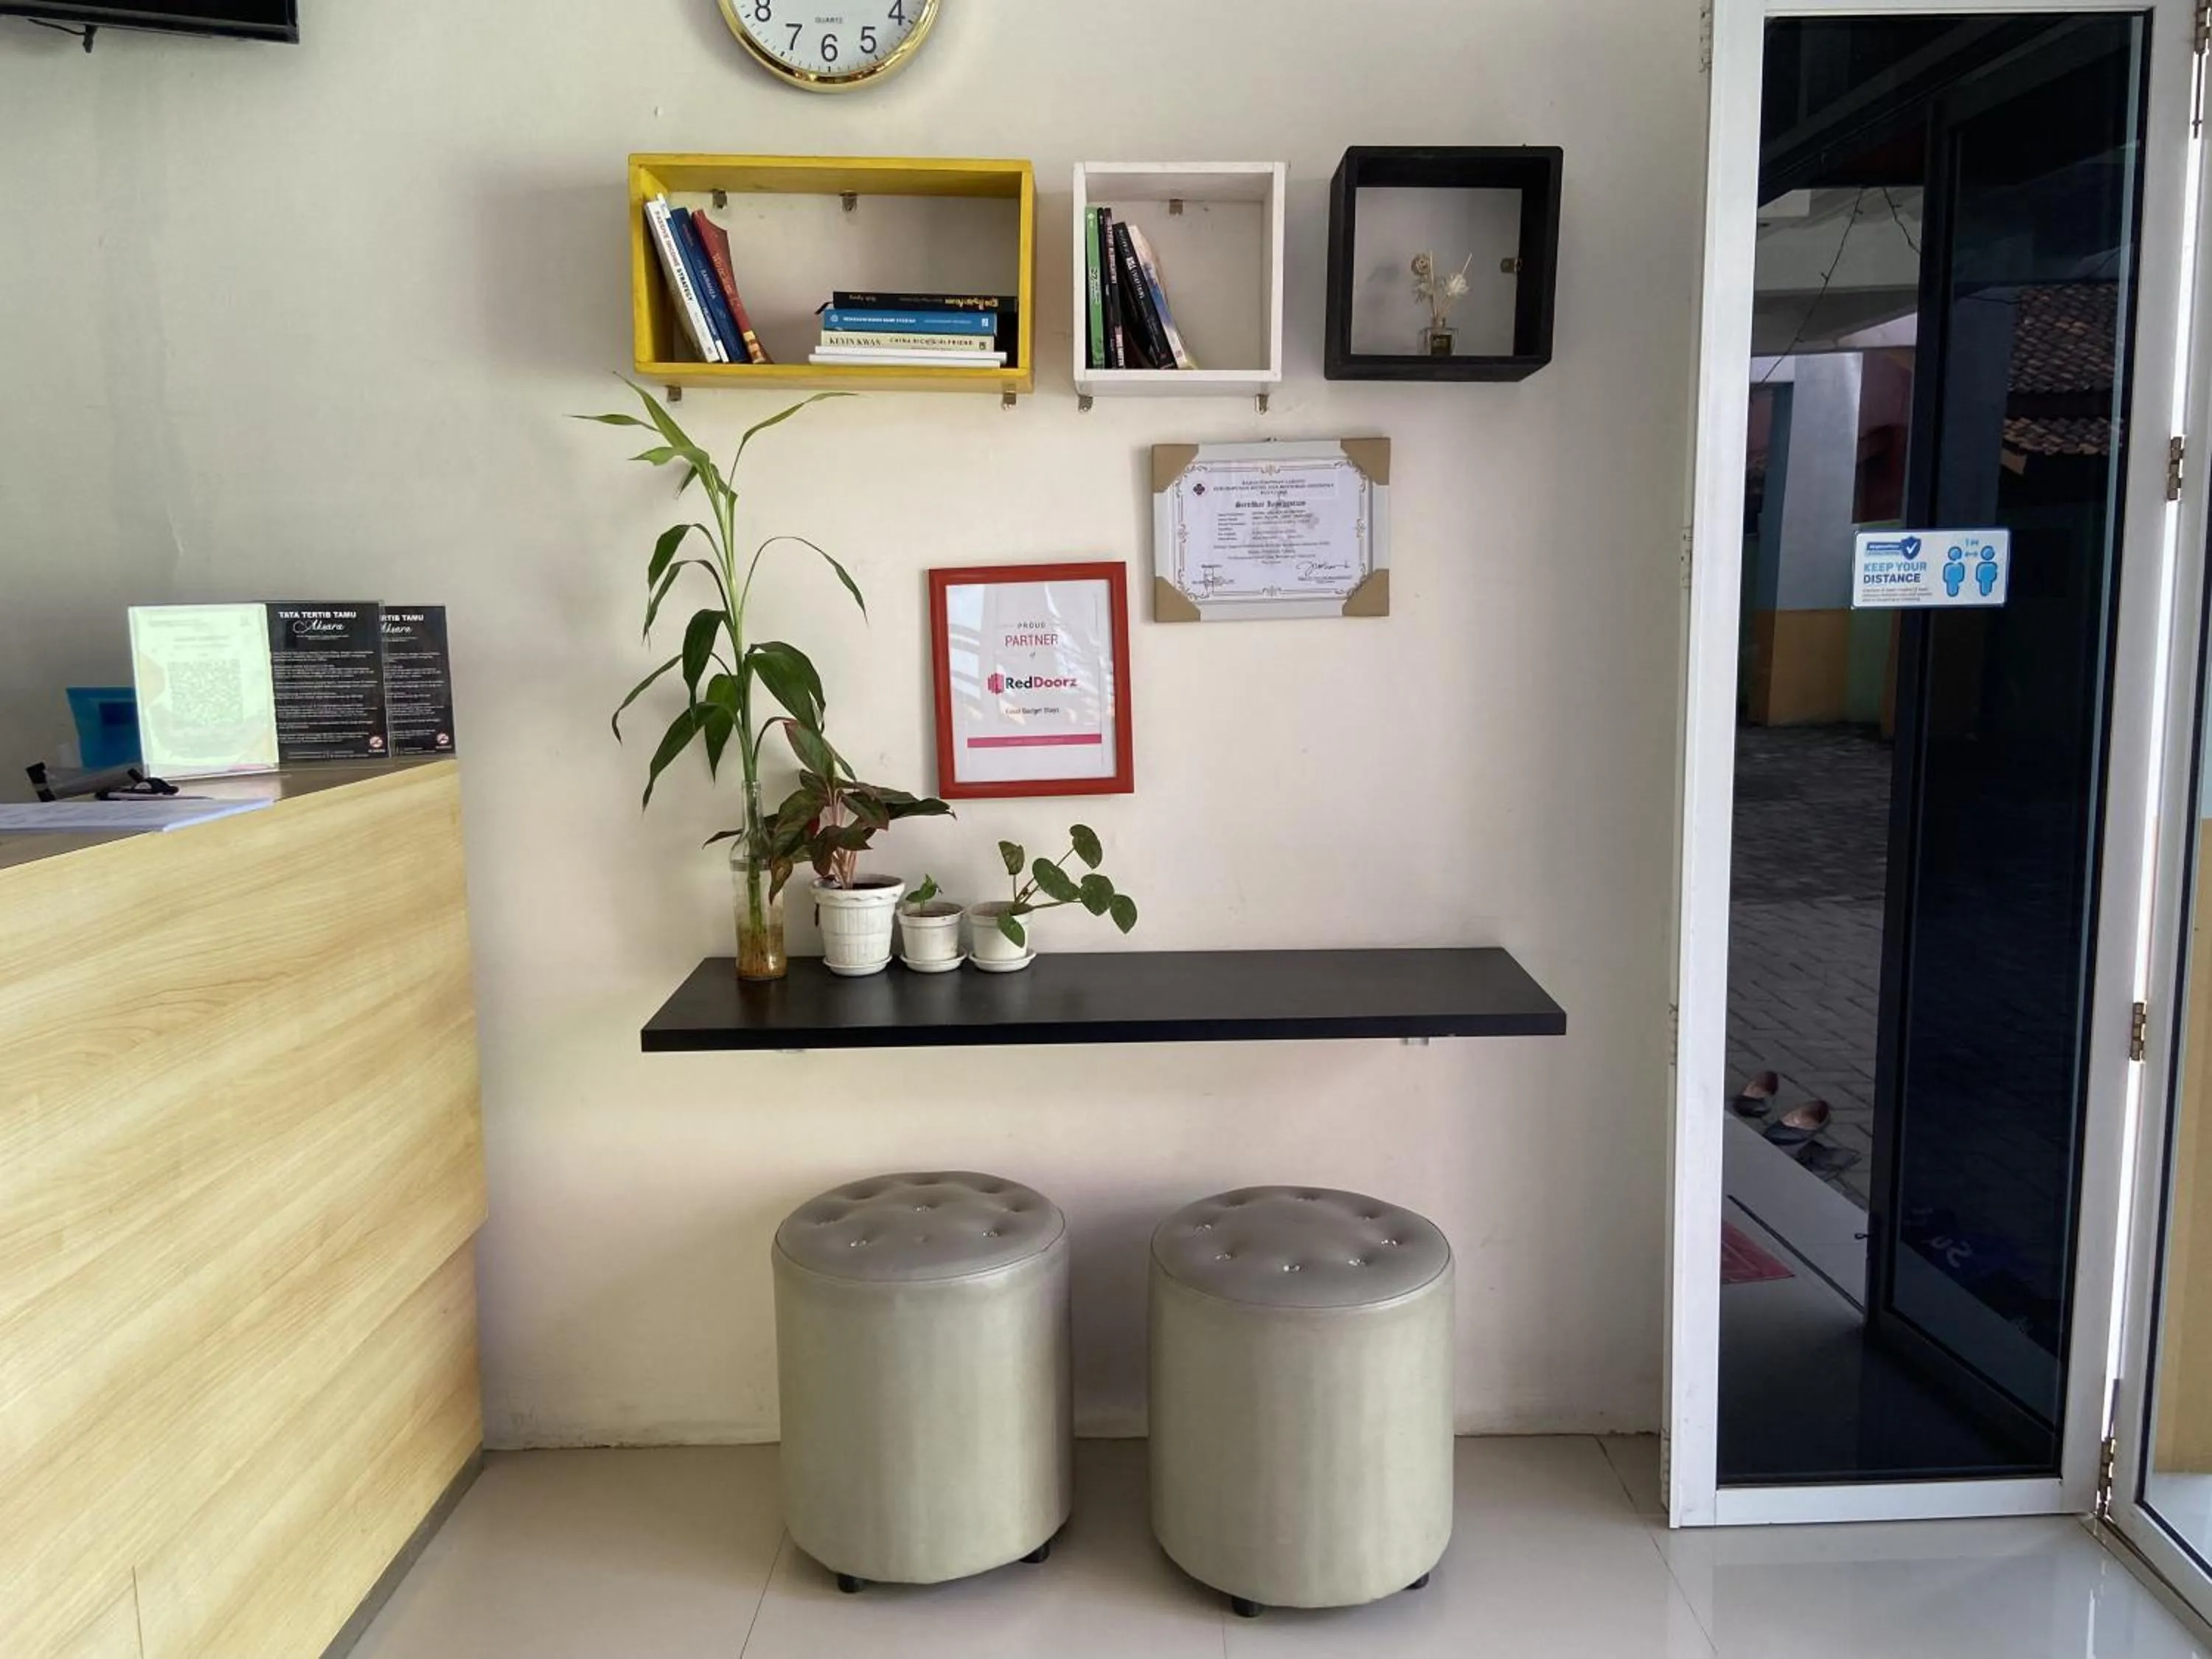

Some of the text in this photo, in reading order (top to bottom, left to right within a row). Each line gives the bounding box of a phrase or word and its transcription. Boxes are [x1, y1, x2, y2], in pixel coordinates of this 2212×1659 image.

[754, 0, 772, 22] 8
[888, 0, 905, 26] 4
[785, 23, 803, 50] 7
[821, 33, 838, 62] 6
[860, 26, 877, 54] 5
[676, 267, 694, 301] STRATEGY
[1863, 561, 1927, 572] KEEP YOUR
[1863, 573, 1921, 584] DISTANCE
[1004, 633, 1058, 647] PARTNER
[1006, 675, 1077, 689] RedDoorz
